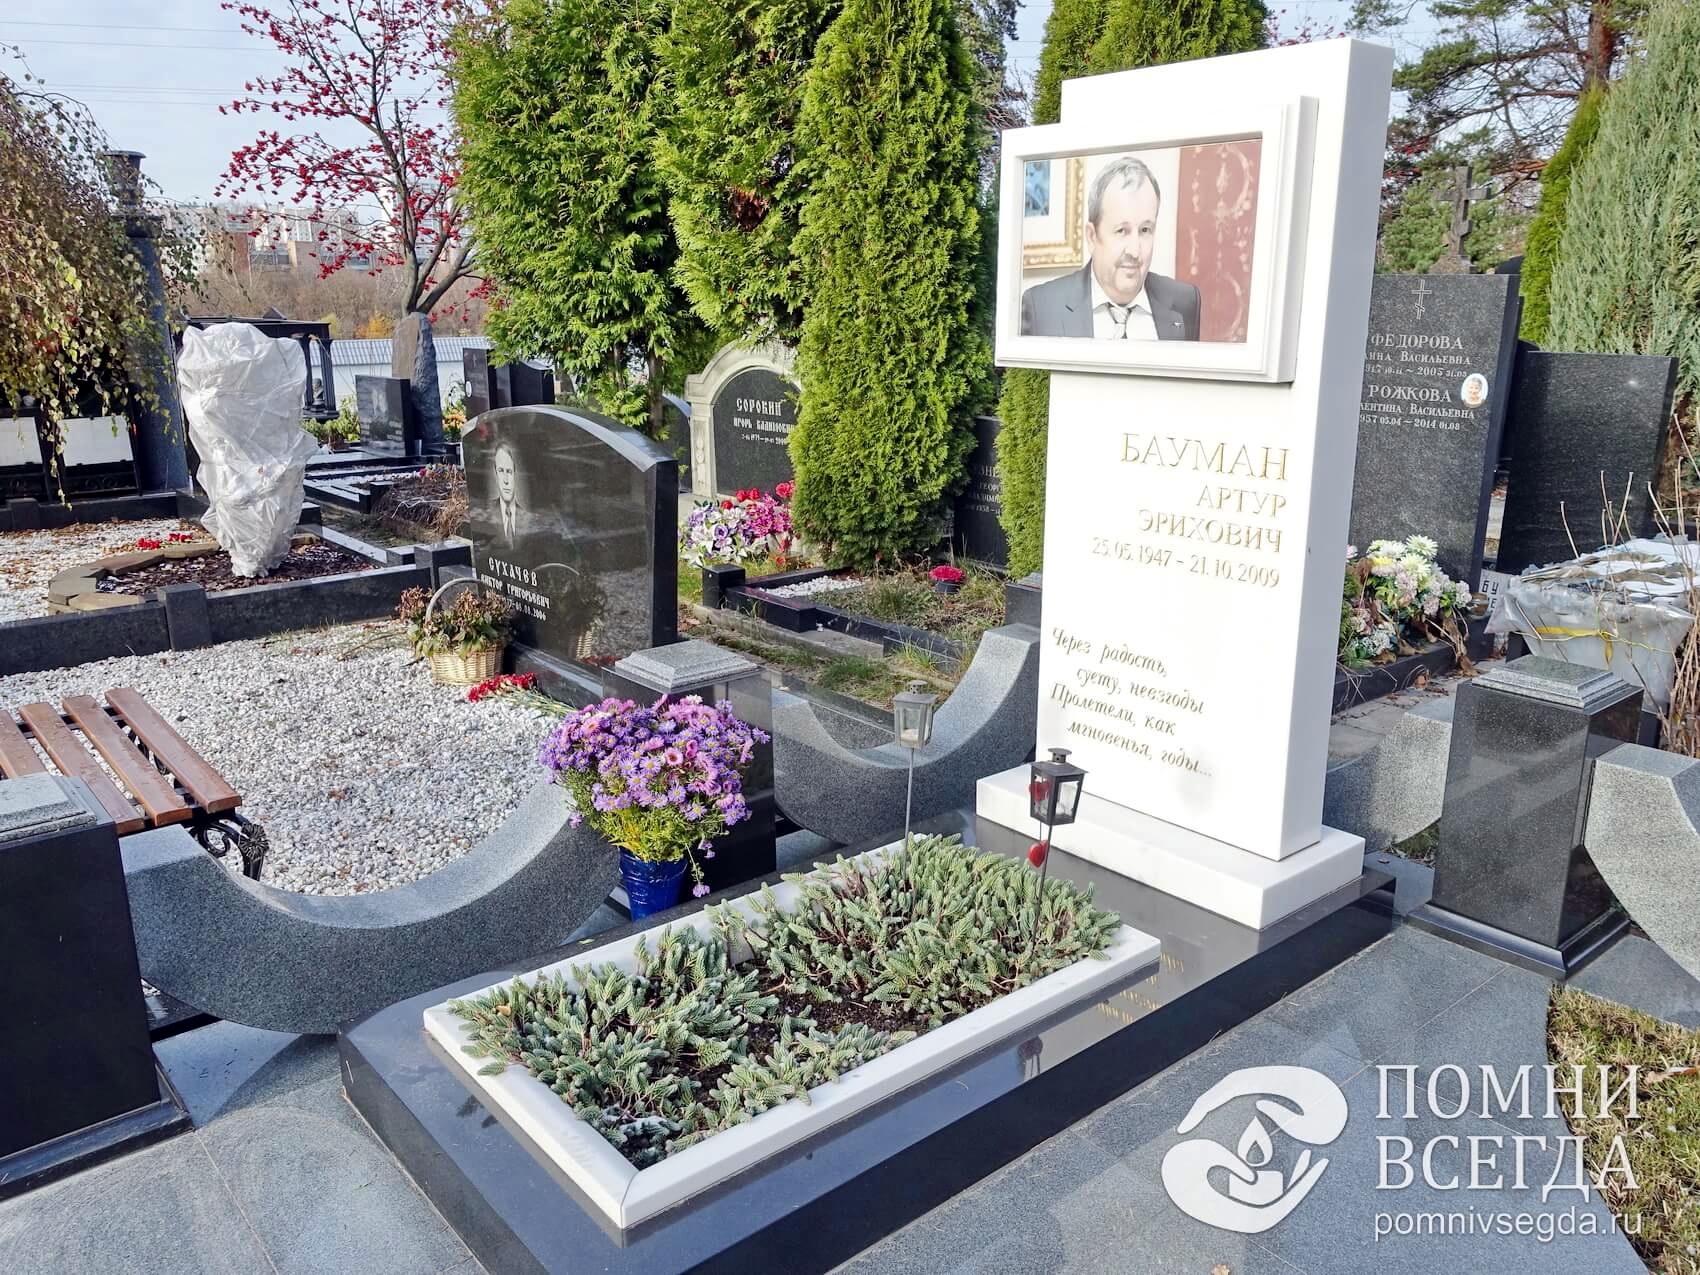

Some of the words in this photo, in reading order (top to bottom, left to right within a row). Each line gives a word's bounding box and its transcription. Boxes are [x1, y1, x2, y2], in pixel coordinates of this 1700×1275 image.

[1371, 333, 1463, 350] ФЕДОРОВА
[1417, 366, 1443, 377] 2005
[736, 397, 782, 416] СОРОКИН
[1368, 384, 1451, 402] РОЖКОВА
[1414, 418, 1436, 429] 2014
[1121, 432, 1289, 481] БАУМАН
[1196, 484, 1287, 518] АРТУР
[1138, 508, 1283, 553] ЭРИХОВИЧ
[1092, 536, 1173, 567] 25.05.1947
[1189, 554, 1280, 588] 21.10.2009
[1052, 627, 1092, 655] Через
[1099, 644, 1168, 678] радость,
[1051, 683, 1136, 727] Пролетели,
[1144, 715, 1177, 736] как
[1076, 668, 1122, 695] суету,
[1130, 681, 1205, 714] невзгоды
[1067, 721, 1152, 760] мгновенья,
